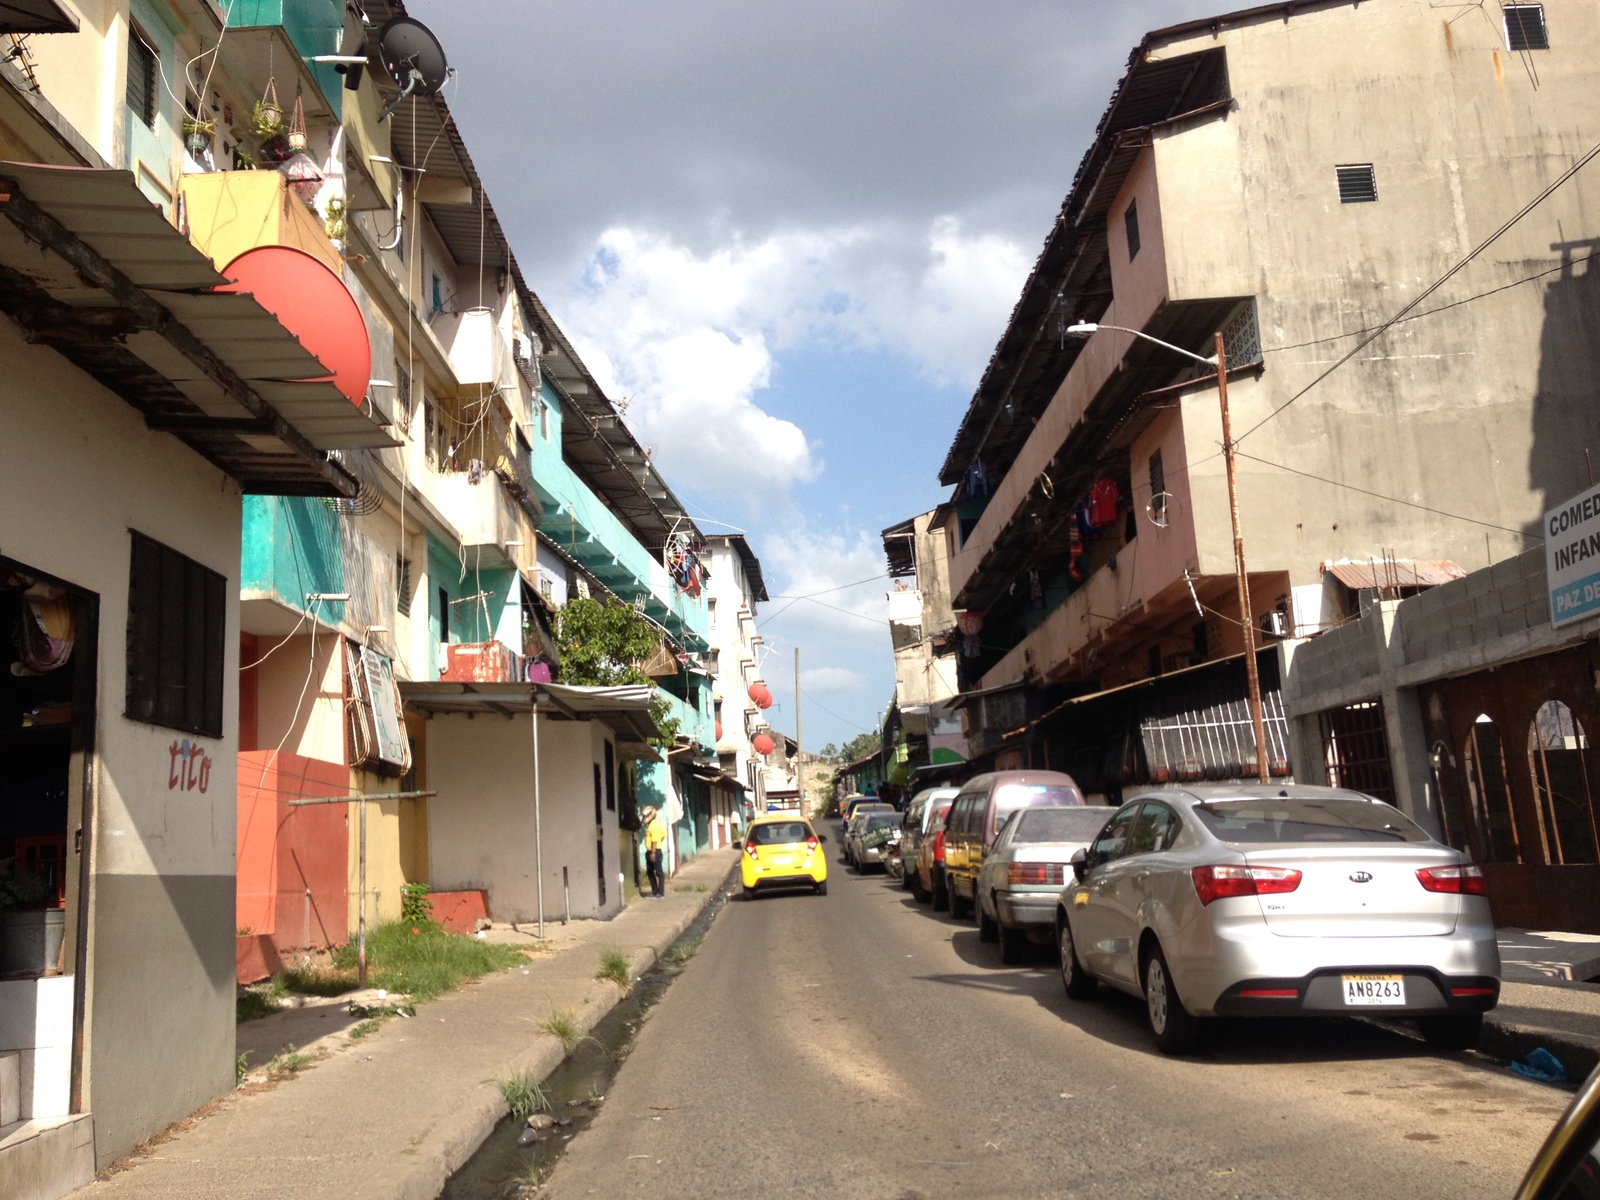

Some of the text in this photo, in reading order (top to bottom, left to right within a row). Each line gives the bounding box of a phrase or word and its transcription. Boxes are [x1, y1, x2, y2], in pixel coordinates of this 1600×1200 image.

[1554, 531, 1600, 572] INFAN
[1556, 580, 1600, 614] PAZ DE
[168, 738, 212, 794] tito
[1348, 981, 1401, 998] AN8263
